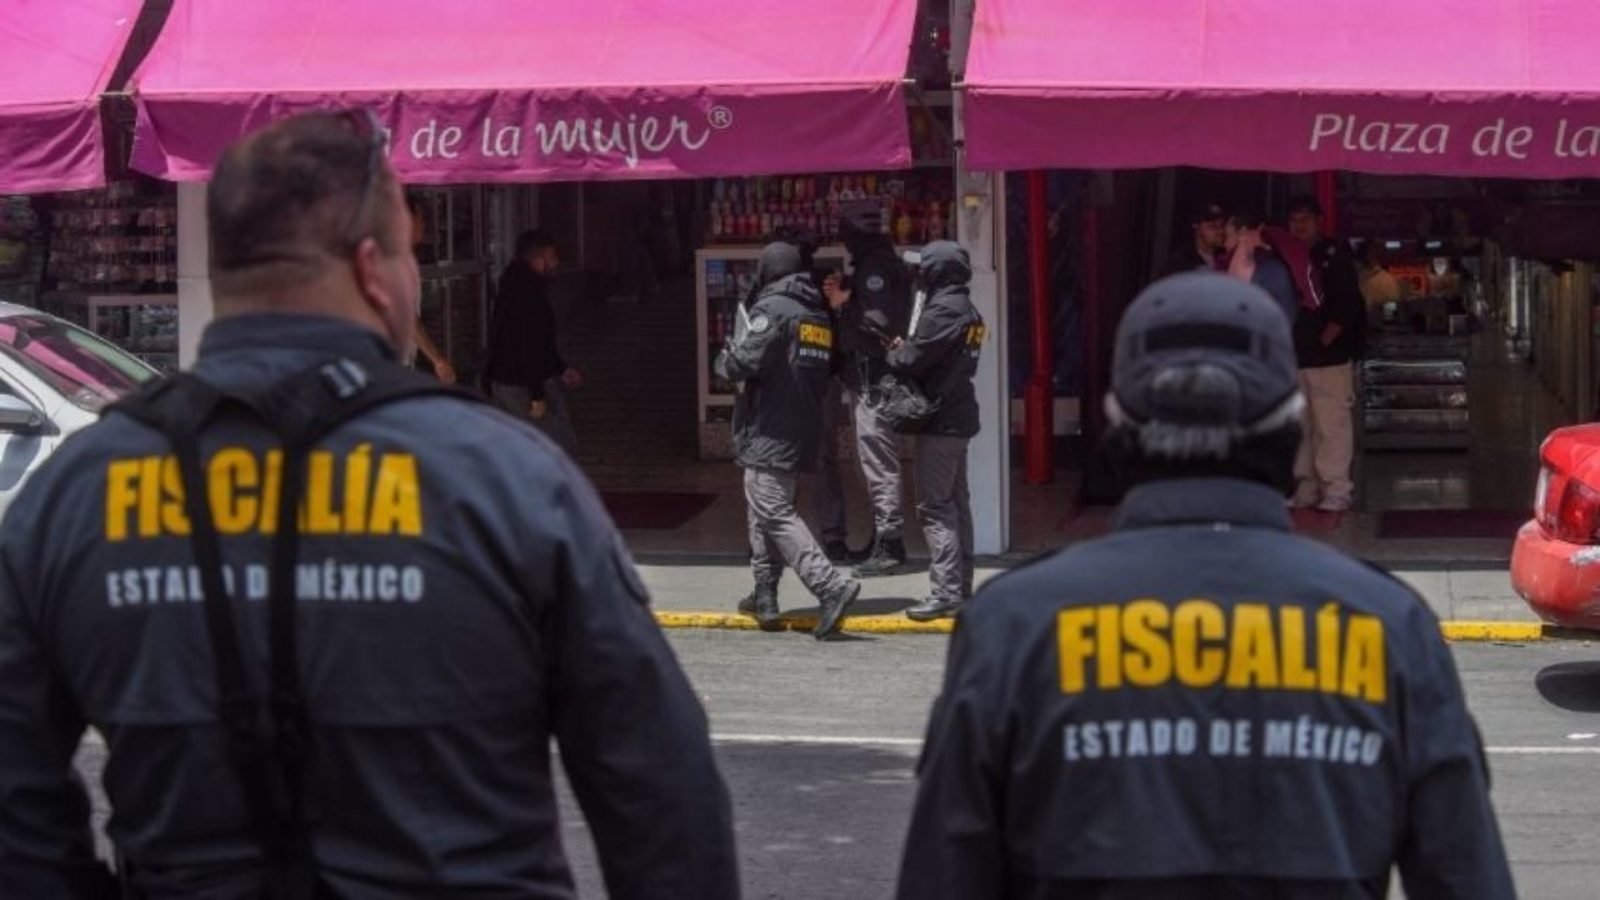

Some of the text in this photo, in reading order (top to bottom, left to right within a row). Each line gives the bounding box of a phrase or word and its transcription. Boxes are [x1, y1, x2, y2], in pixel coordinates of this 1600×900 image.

[410, 119, 463, 159] de
[481, 117, 521, 157] la
[1309, 113, 1600, 159] Plaza de la
[105, 564, 236, 607] ESTA
[295, 556, 424, 604] MÉXICO
[1056, 598, 1387, 704] FISCALÍA
[1062, 713, 1385, 766] ESTADO DE MÉXICO
